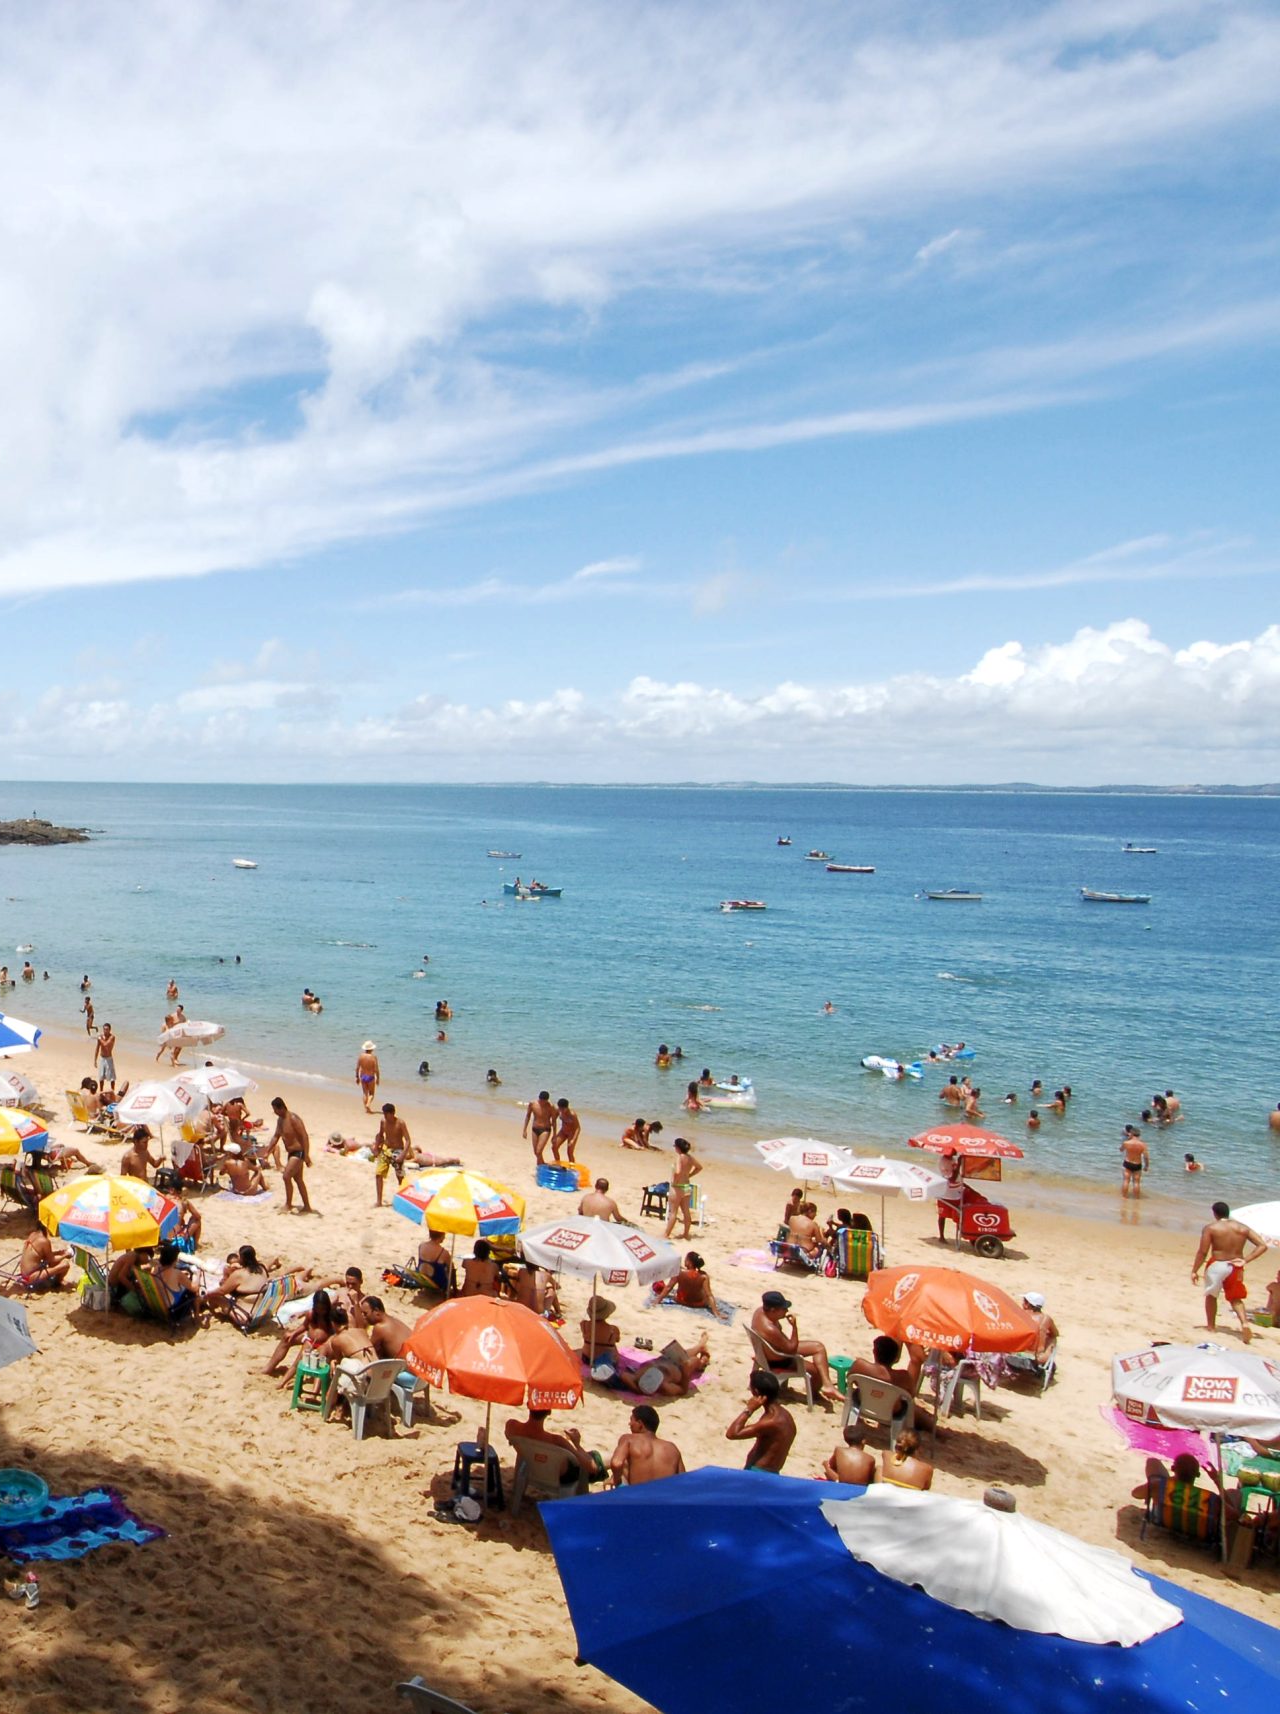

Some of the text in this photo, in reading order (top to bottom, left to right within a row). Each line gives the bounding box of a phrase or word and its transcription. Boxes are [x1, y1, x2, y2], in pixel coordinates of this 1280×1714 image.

[559, 1229, 584, 1241] NOVA
[551, 1236, 579, 1248] SCHIN
[1192, 1377, 1232, 1389] NOVA
[538, 1391, 567, 1399] TRIGO
[1186, 1388, 1232, 1400] SCHIN
[1128, 1400, 1142, 1408] NOVA
